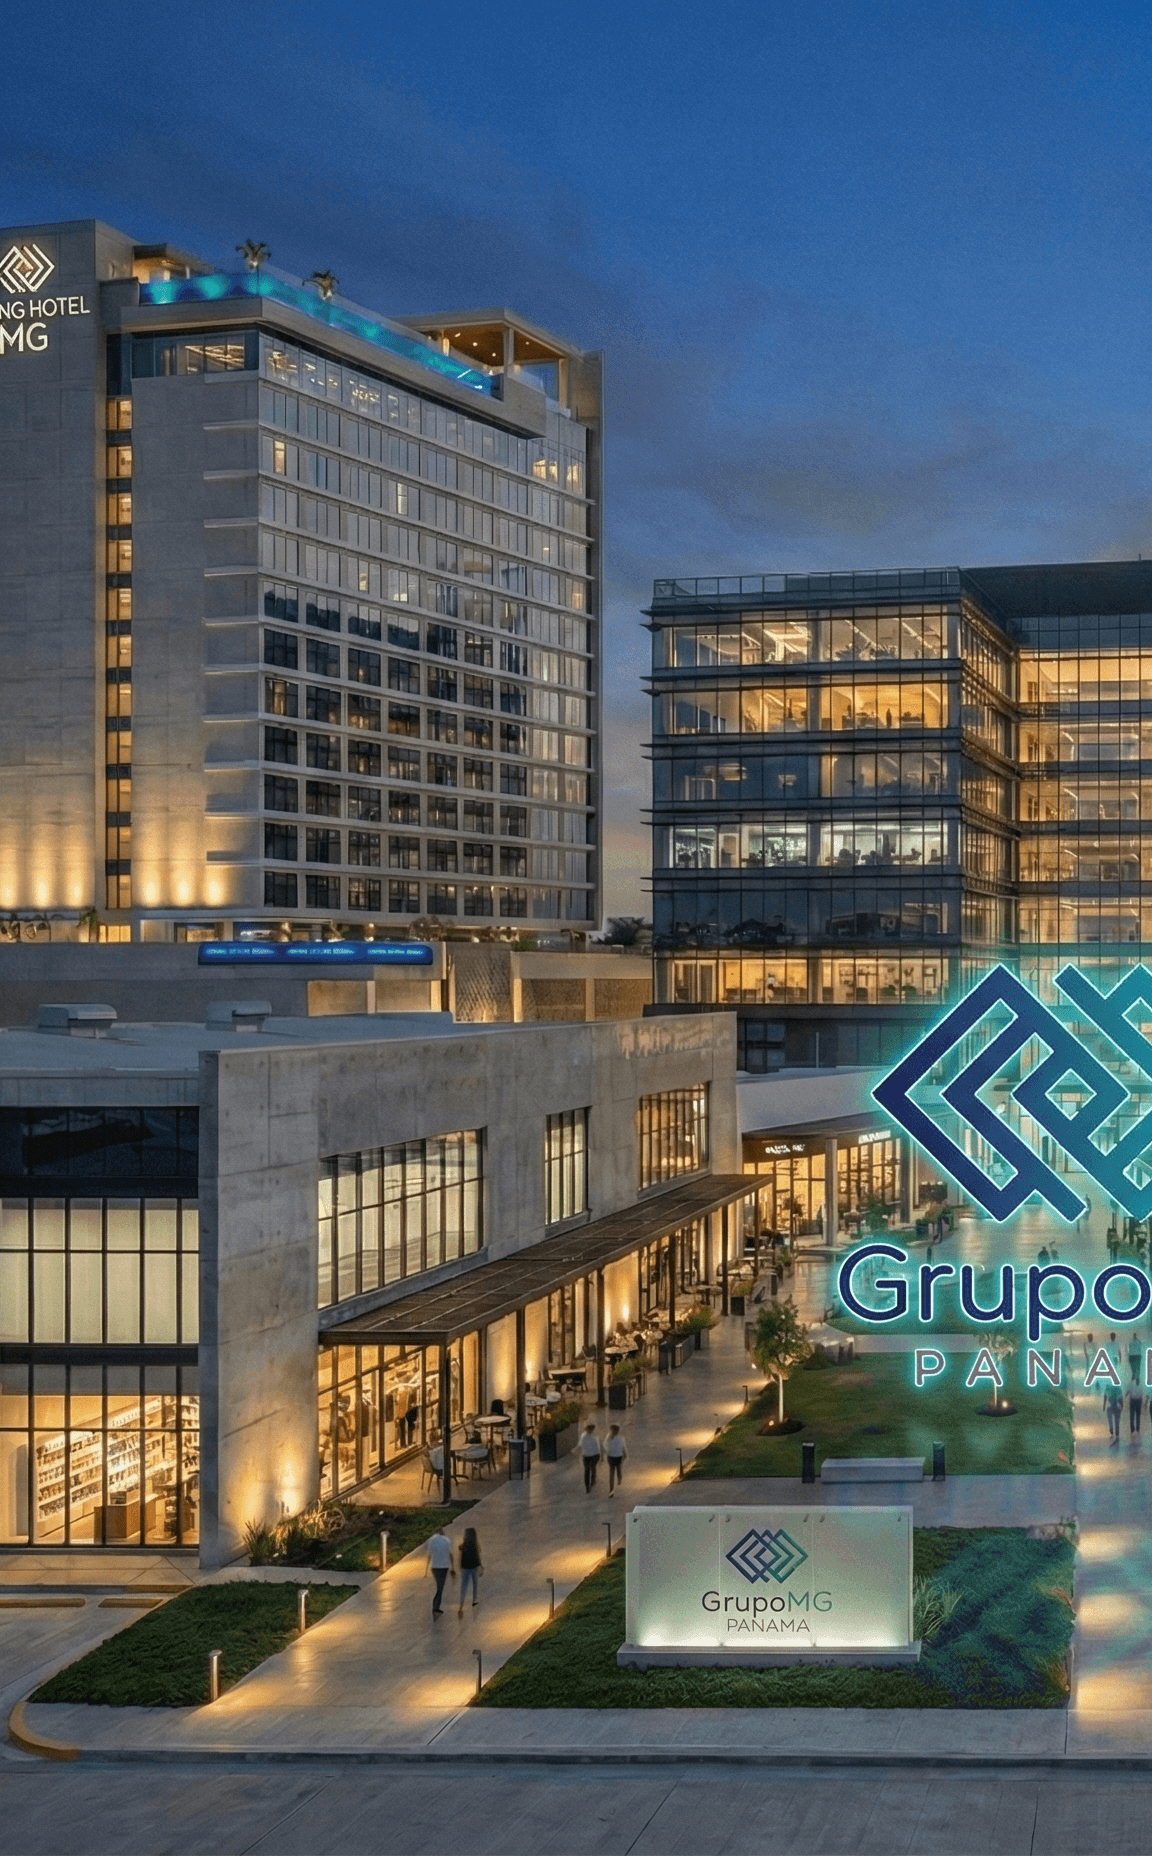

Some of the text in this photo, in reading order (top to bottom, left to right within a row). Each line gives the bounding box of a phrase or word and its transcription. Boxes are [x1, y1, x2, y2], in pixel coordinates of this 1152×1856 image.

[29, 295, 91, 318] HOTEL
[0, 322, 48, 355] MG
[701, 1590, 833, 1618] GrupoMG
[727, 1618, 811, 1632] PANAMA
